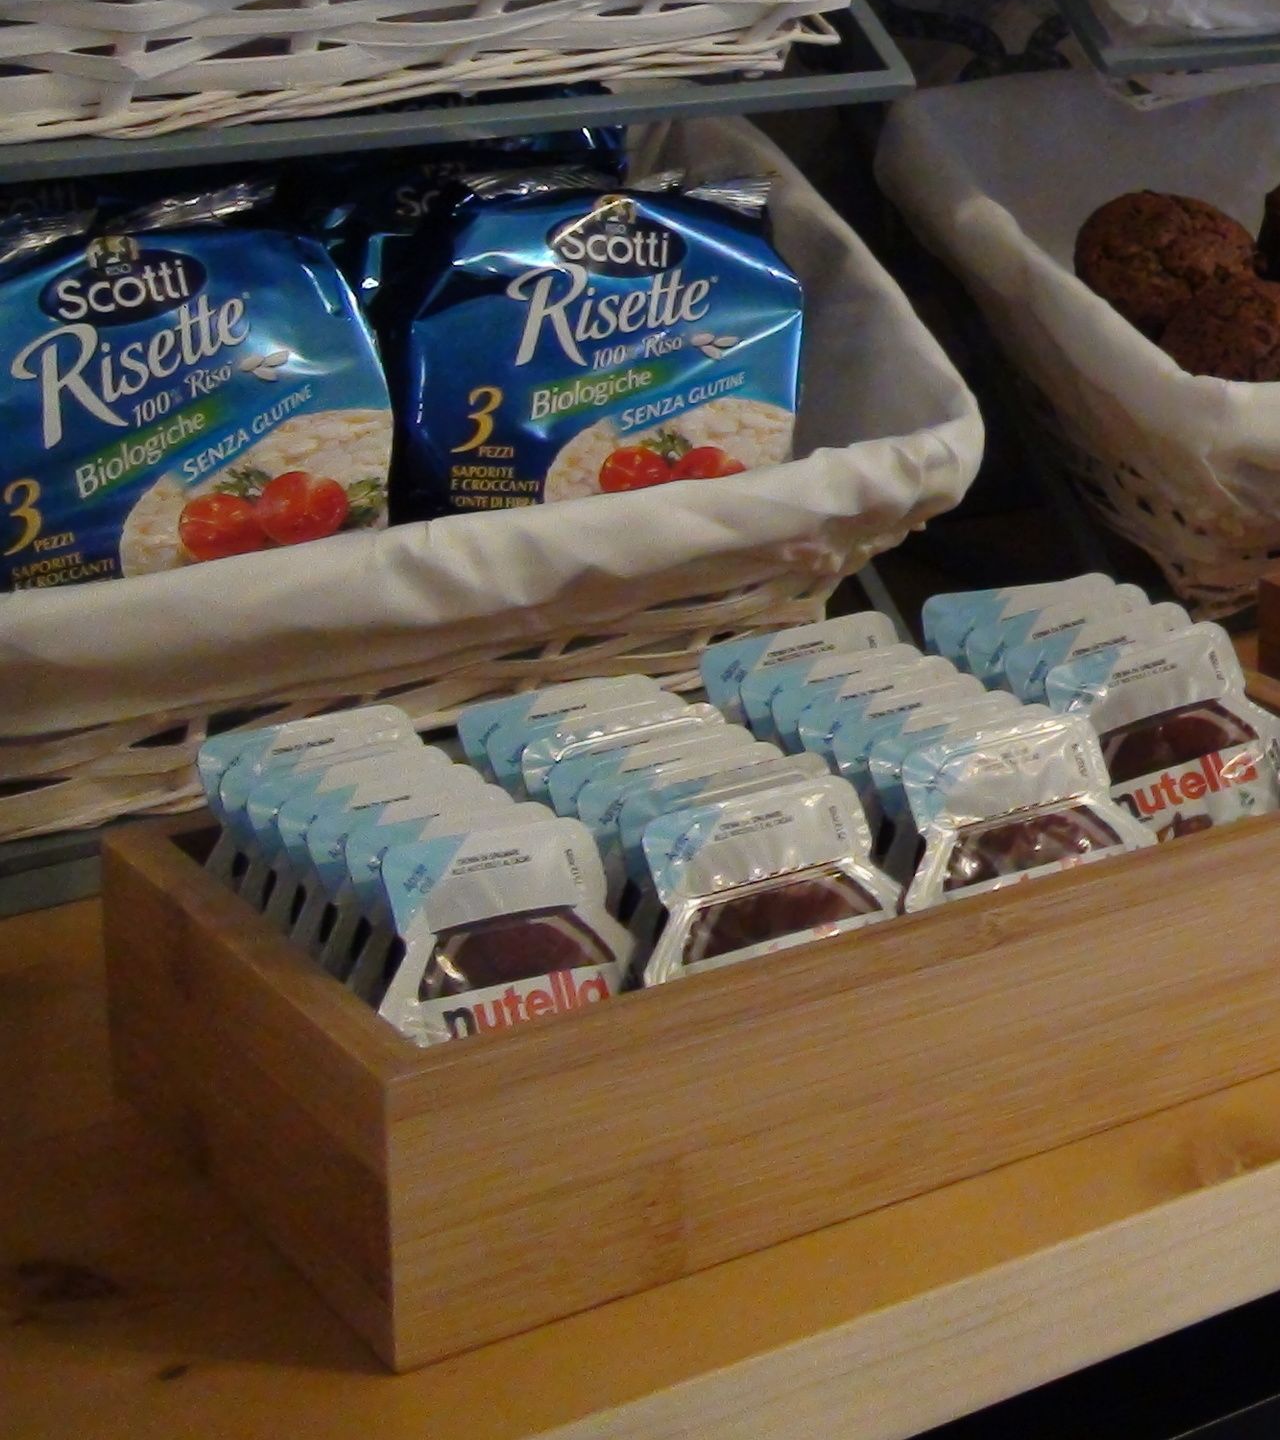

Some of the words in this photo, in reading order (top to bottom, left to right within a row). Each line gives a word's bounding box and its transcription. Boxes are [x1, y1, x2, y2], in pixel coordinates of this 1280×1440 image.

[560, 226, 671, 268] Scotti
[57, 259, 191, 320] Scotti
[507, 267, 712, 367] Risette
[10, 295, 251, 450] Risette
[642, 331, 683, 360] Riso
[184, 367, 232, 398] Riso
[530, 369, 652, 421] Biologiche
[621, 395, 685, 431] SENZA
[688, 371, 746, 404] GLUTINE
[183, 428, 251, 483] SENZA
[252, 384, 313, 435] GLUTINE
[451, 386, 502, 454] 3
[75, 412, 205, 499] Biologiche
[4, 478, 42, 556] 3
[1112, 750, 1259, 824] nutella
[442, 968, 611, 1040] nutella
